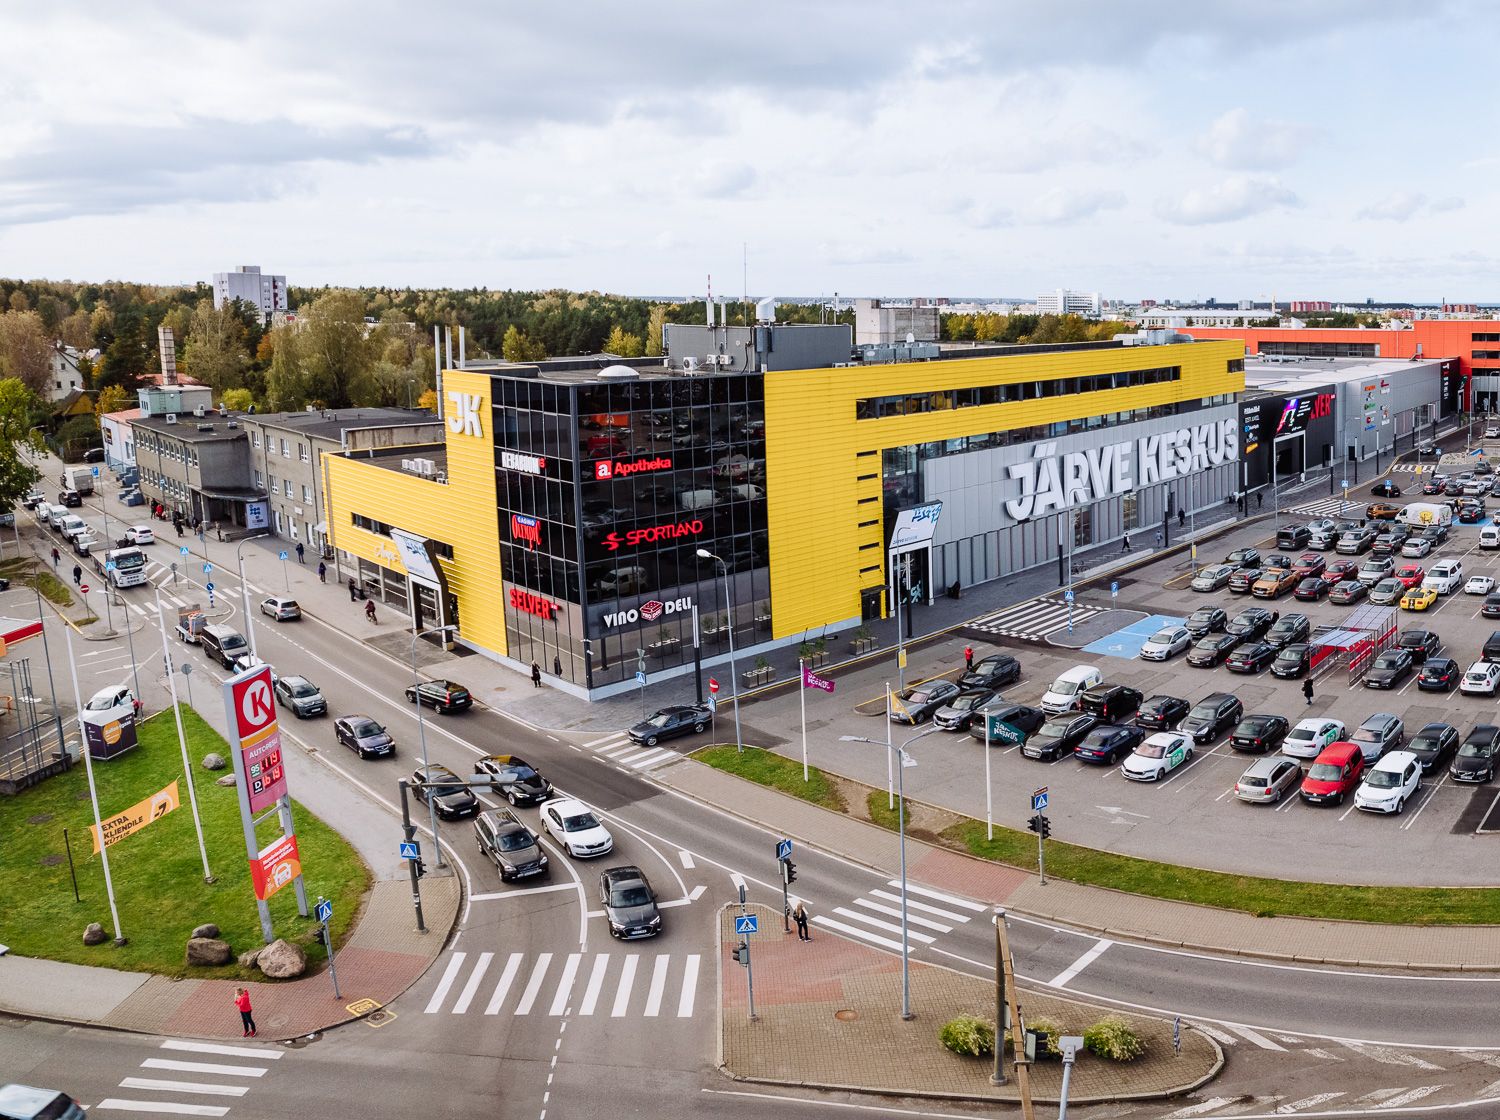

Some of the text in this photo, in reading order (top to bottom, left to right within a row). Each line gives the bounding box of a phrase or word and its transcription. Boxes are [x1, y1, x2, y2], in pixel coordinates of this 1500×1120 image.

[448, 391, 483, 438] JK
[614, 457, 672, 476] Apotheka
[1006, 418, 1239, 521] JÄRVE KESKUS
[626, 520, 703, 546] SPORTLAND
[510, 588, 550, 620] SELVER
[603, 596, 692, 628] VINO DELI
[101, 815, 130, 832] EXTRA
[103, 815, 144, 840] KLIENDILE
